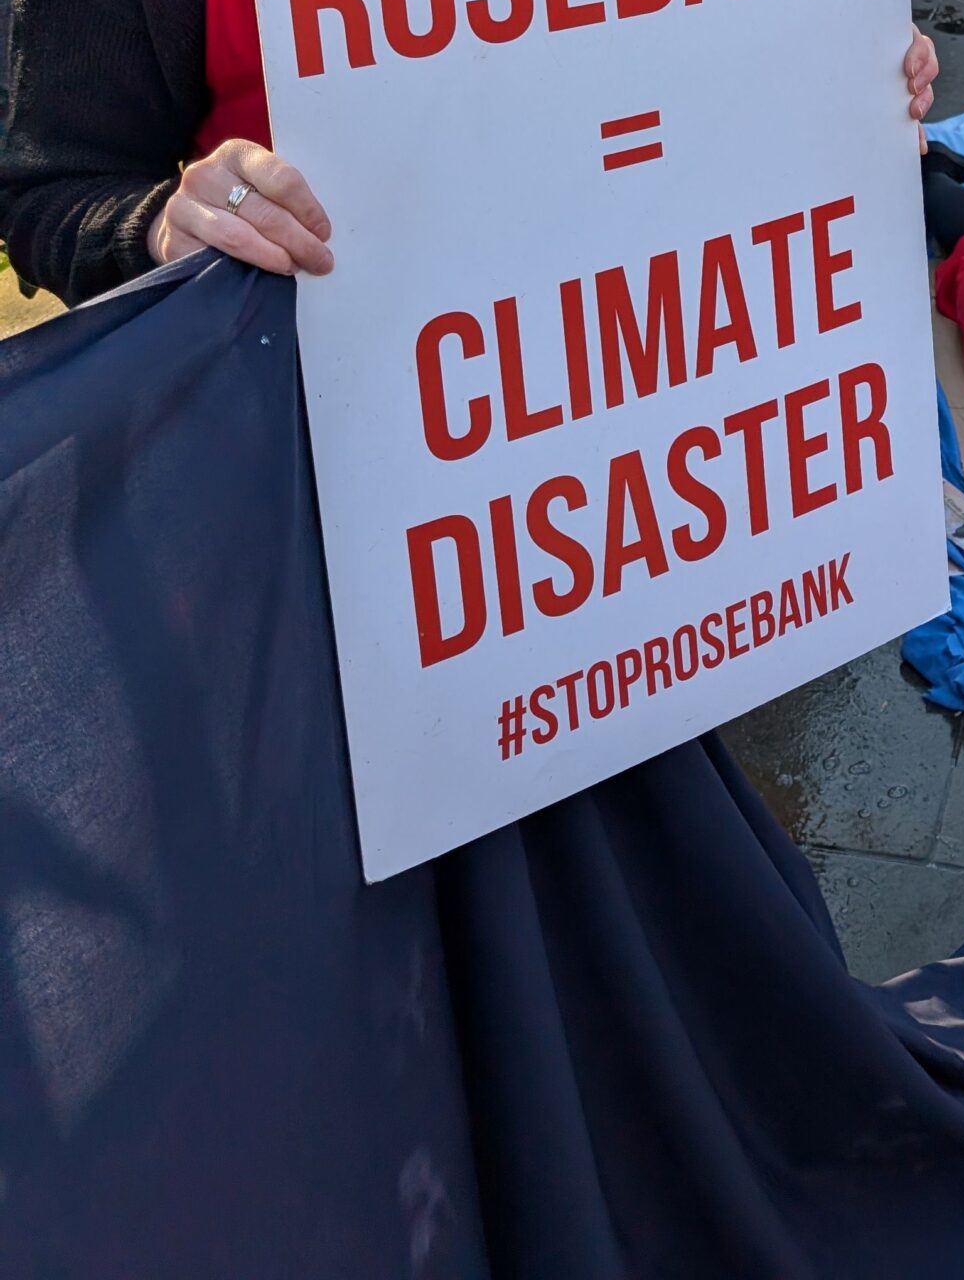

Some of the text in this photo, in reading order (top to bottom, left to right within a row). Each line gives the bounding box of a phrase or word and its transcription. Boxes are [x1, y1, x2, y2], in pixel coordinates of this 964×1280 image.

[601, 112, 662, 170] =
[416, 196, 861, 460] CLIMATE
[407, 363, 892, 667] DISASTER
[498, 555, 852, 759] #STOPROSEBANK
